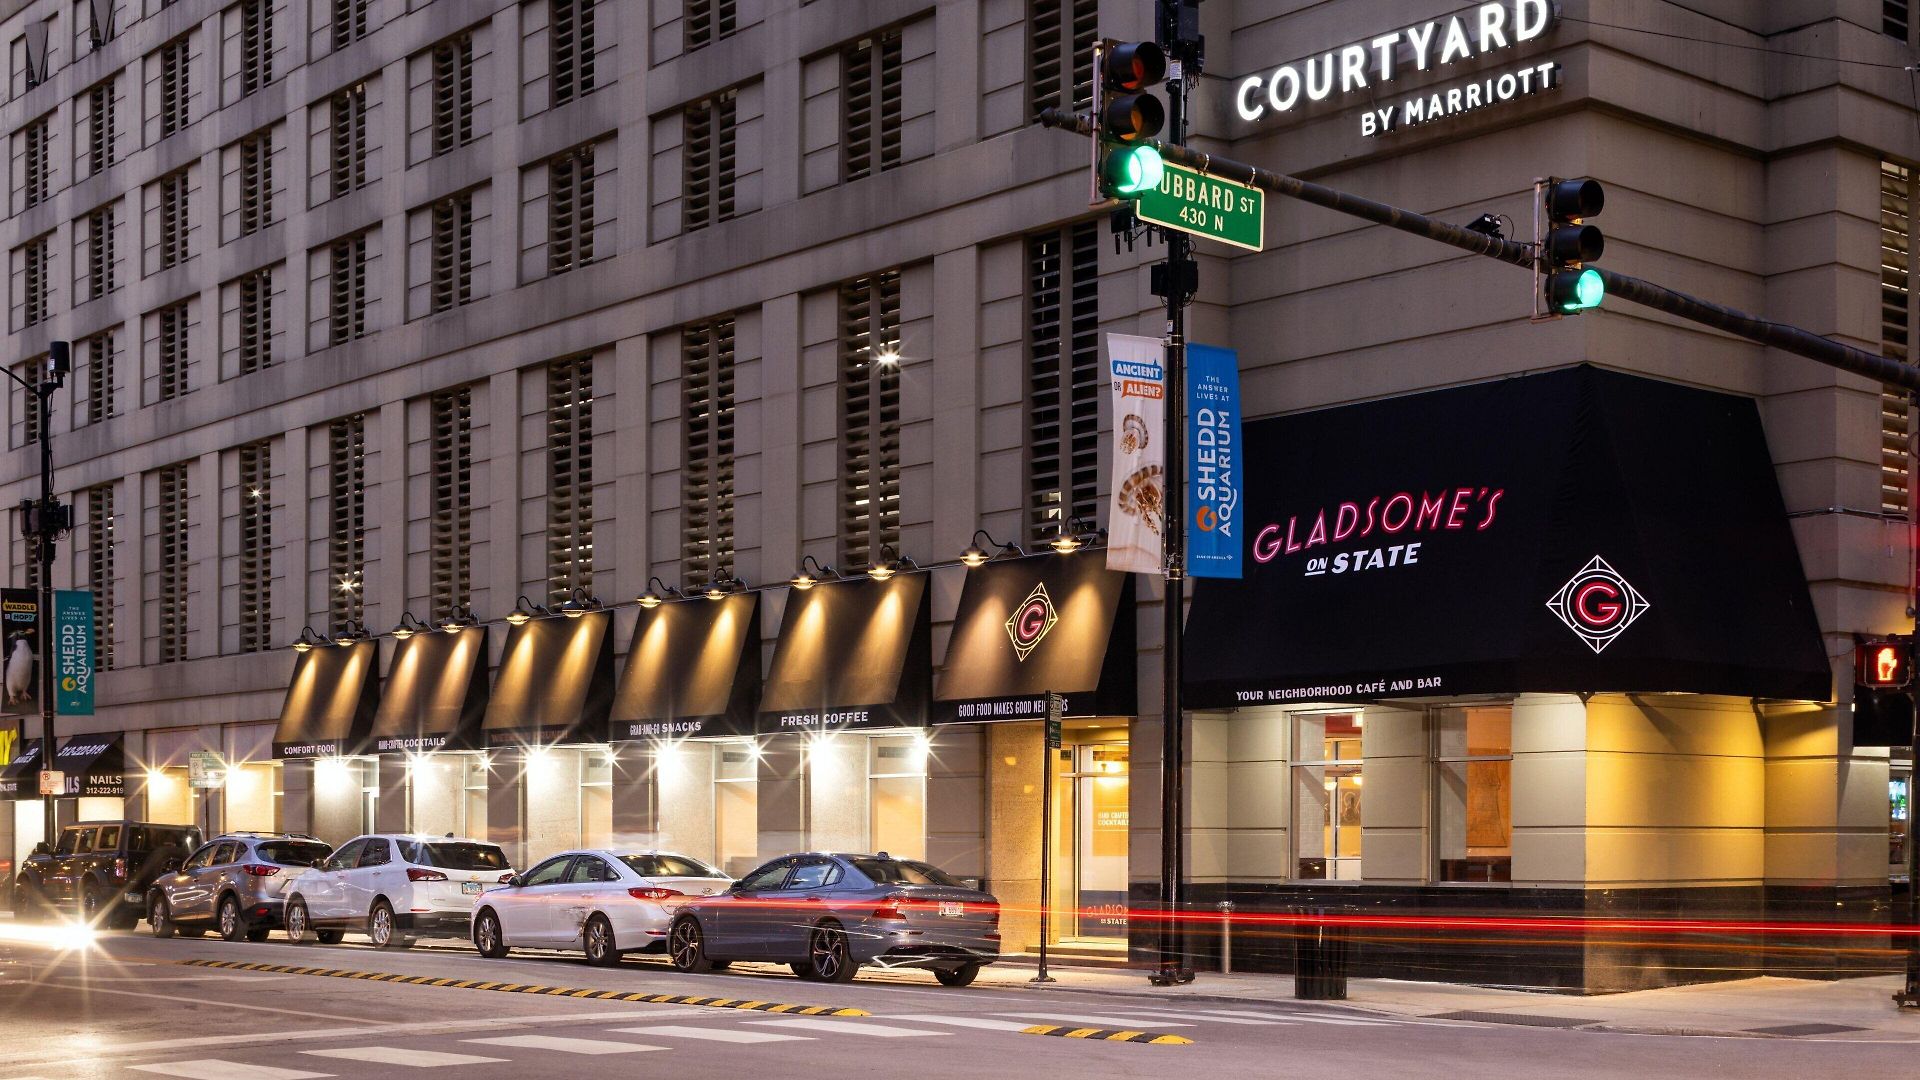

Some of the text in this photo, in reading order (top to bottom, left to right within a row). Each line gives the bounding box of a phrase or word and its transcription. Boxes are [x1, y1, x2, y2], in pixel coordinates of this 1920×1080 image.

[1237, 0, 1549, 120] COURTYARD
[1361, 62, 1555, 136] BY MARRIOTT
[1152, 171, 1255, 215] UBBARD ST
[1179, 206, 1224, 232] 430 N
[1115, 362, 1161, 379] ANCIENT
[1205, 375, 1220, 384] THE
[1113, 380, 1162, 398] OR ALIEN?
[1196, 392, 1218, 401] LIVES
[1197, 383, 1229, 393] ANSWER
[1197, 408, 1216, 501] SHEDD
[1217, 411, 1238, 538] AQUARIUM
[1252, 487, 1504, 563] GLADSOME'S
[1305, 542, 1422, 576] ON STATE
[1576, 582, 1622, 625] G
[1018, 604, 1045, 640] G
[62, 624, 75, 675] SHEDD
[76, 625, 91, 694] AQUARIUM
[1236, 676, 1442, 701] YOUR NEIGHBORHOOD CAFÉ AND BAR
[780, 711, 869, 727] FRESH COFFEE
[958, 704, 975, 717] GOOD
[976, 703, 992, 716] FOOD
[993, 701, 1014, 715] MAKES
[1015, 700, 1032, 714] GOOD
[661, 721, 702, 733] SNACKS
[284, 744, 336, 755] COMFORT FOOD
[404, 737, 446, 748] COCKTAILS
[90, 775, 123, 785] NAILS
